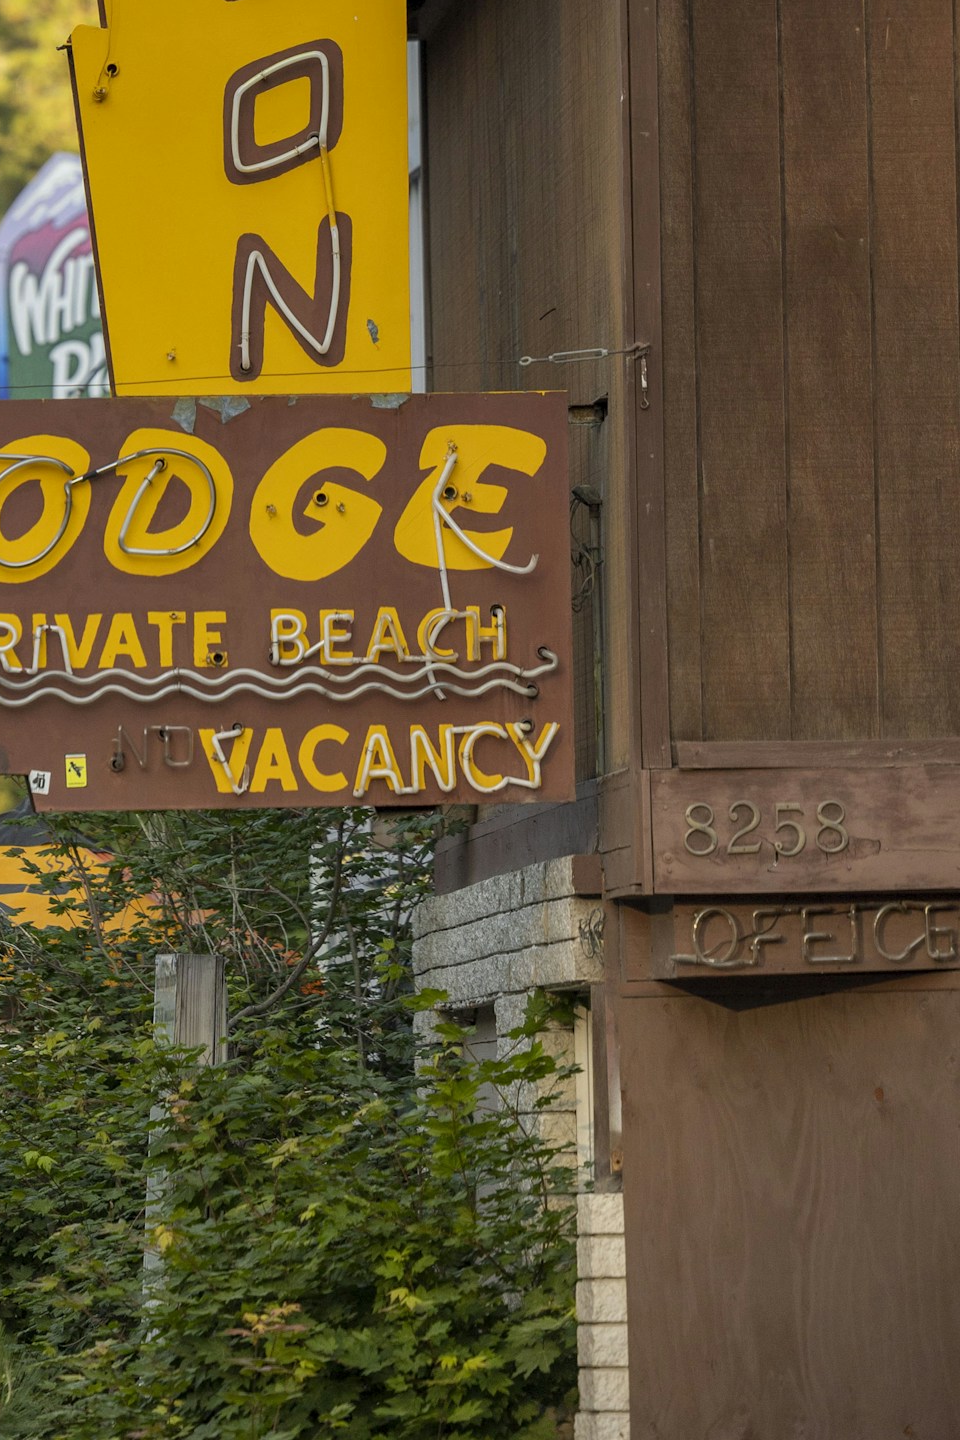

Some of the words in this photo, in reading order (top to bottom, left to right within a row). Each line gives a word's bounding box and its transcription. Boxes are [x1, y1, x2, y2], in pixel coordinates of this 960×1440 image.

[269, 605, 507, 666] BEACH
[112, 724, 194, 769] NO
[198, 720, 561, 797] VACANCY
[684, 800, 850, 857] 8258
